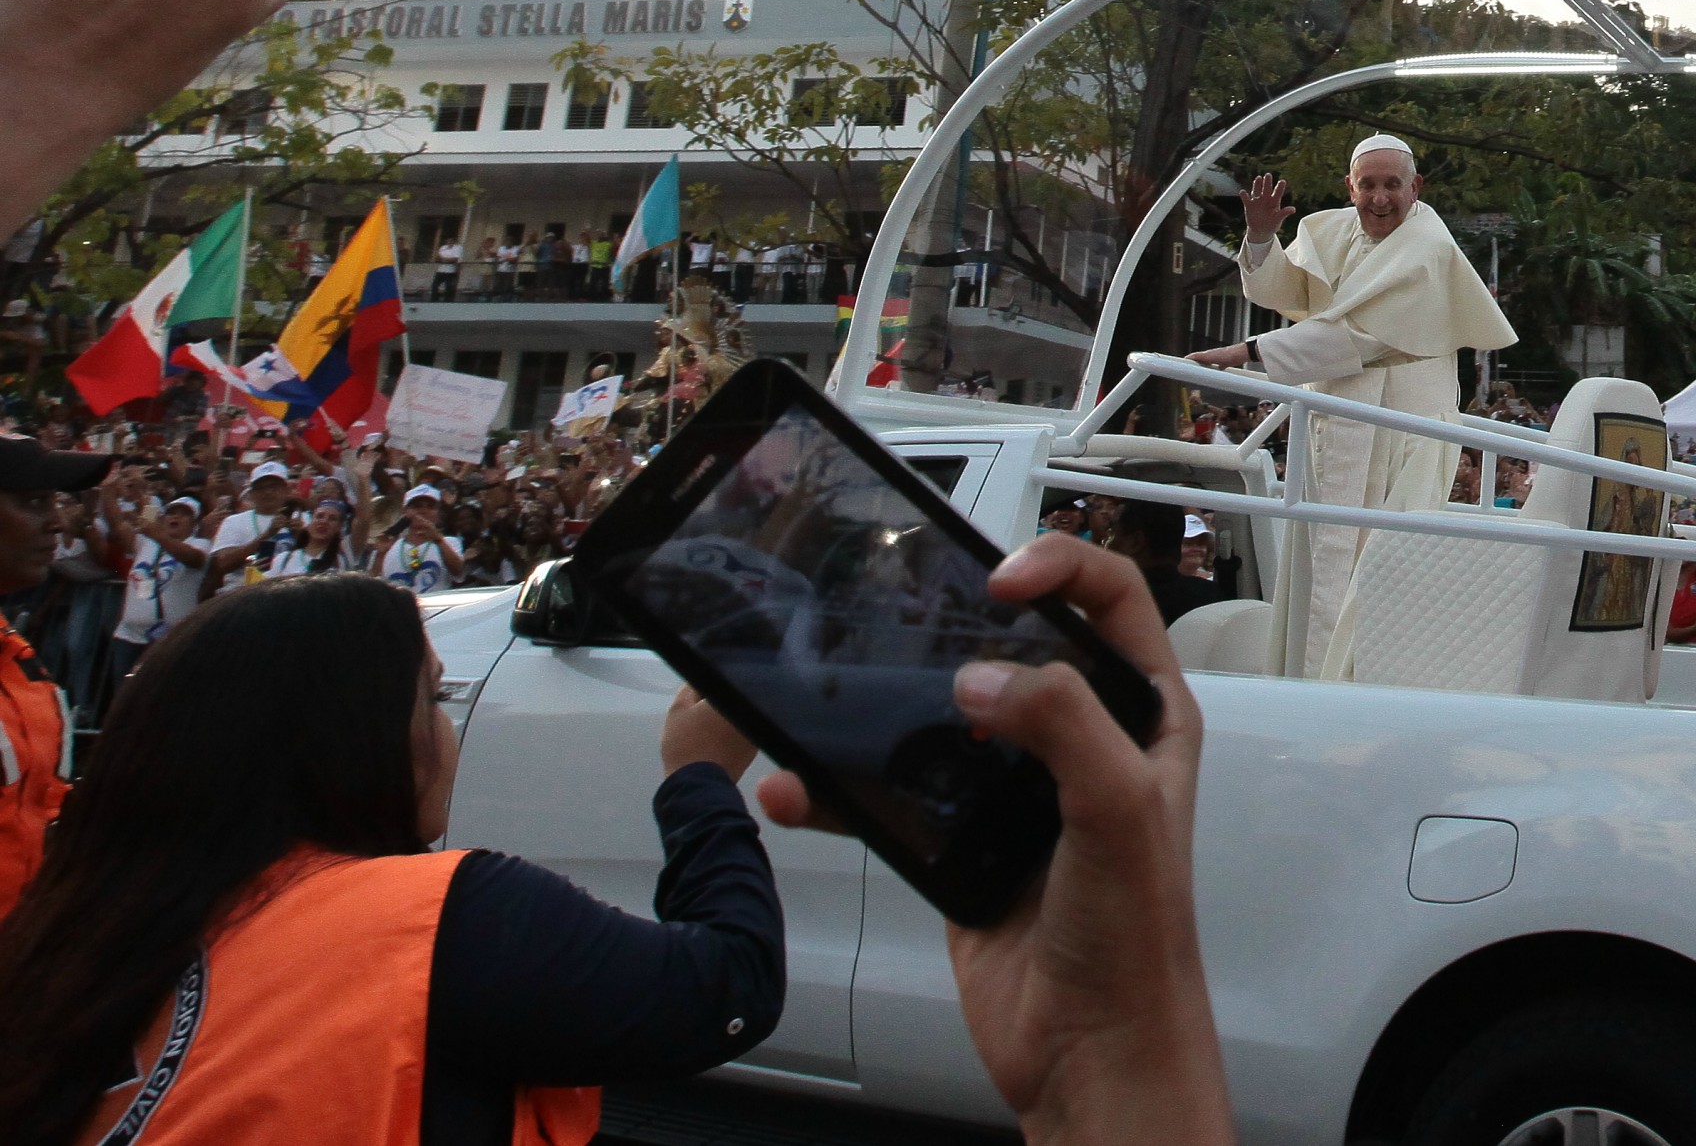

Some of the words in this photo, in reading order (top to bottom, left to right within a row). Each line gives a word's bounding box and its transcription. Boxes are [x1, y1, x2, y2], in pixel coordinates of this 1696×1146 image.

[309, 5, 462, 40] PASTORAL
[477, 2, 587, 37] STELLA
[602, 0, 706, 34] MARIS
[115, 1067, 172, 1136] CIVIL
